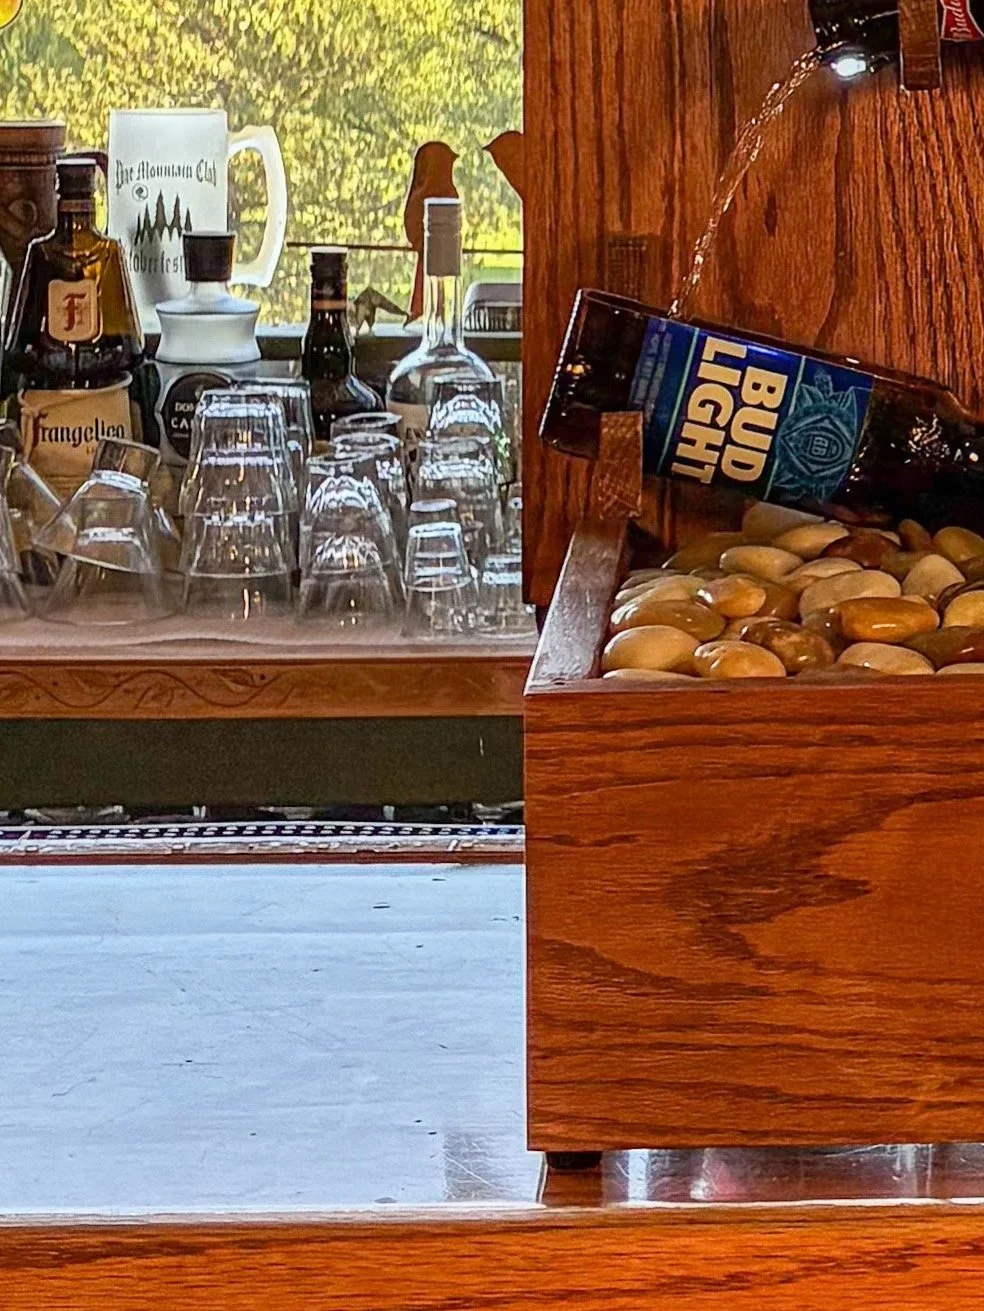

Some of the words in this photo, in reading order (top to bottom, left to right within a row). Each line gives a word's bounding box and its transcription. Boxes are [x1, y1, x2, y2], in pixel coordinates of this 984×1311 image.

[31, 413, 126, 449] Frangelico
[670, 335, 748, 485] LIGHT
[720, 365, 789, 483] BUD
